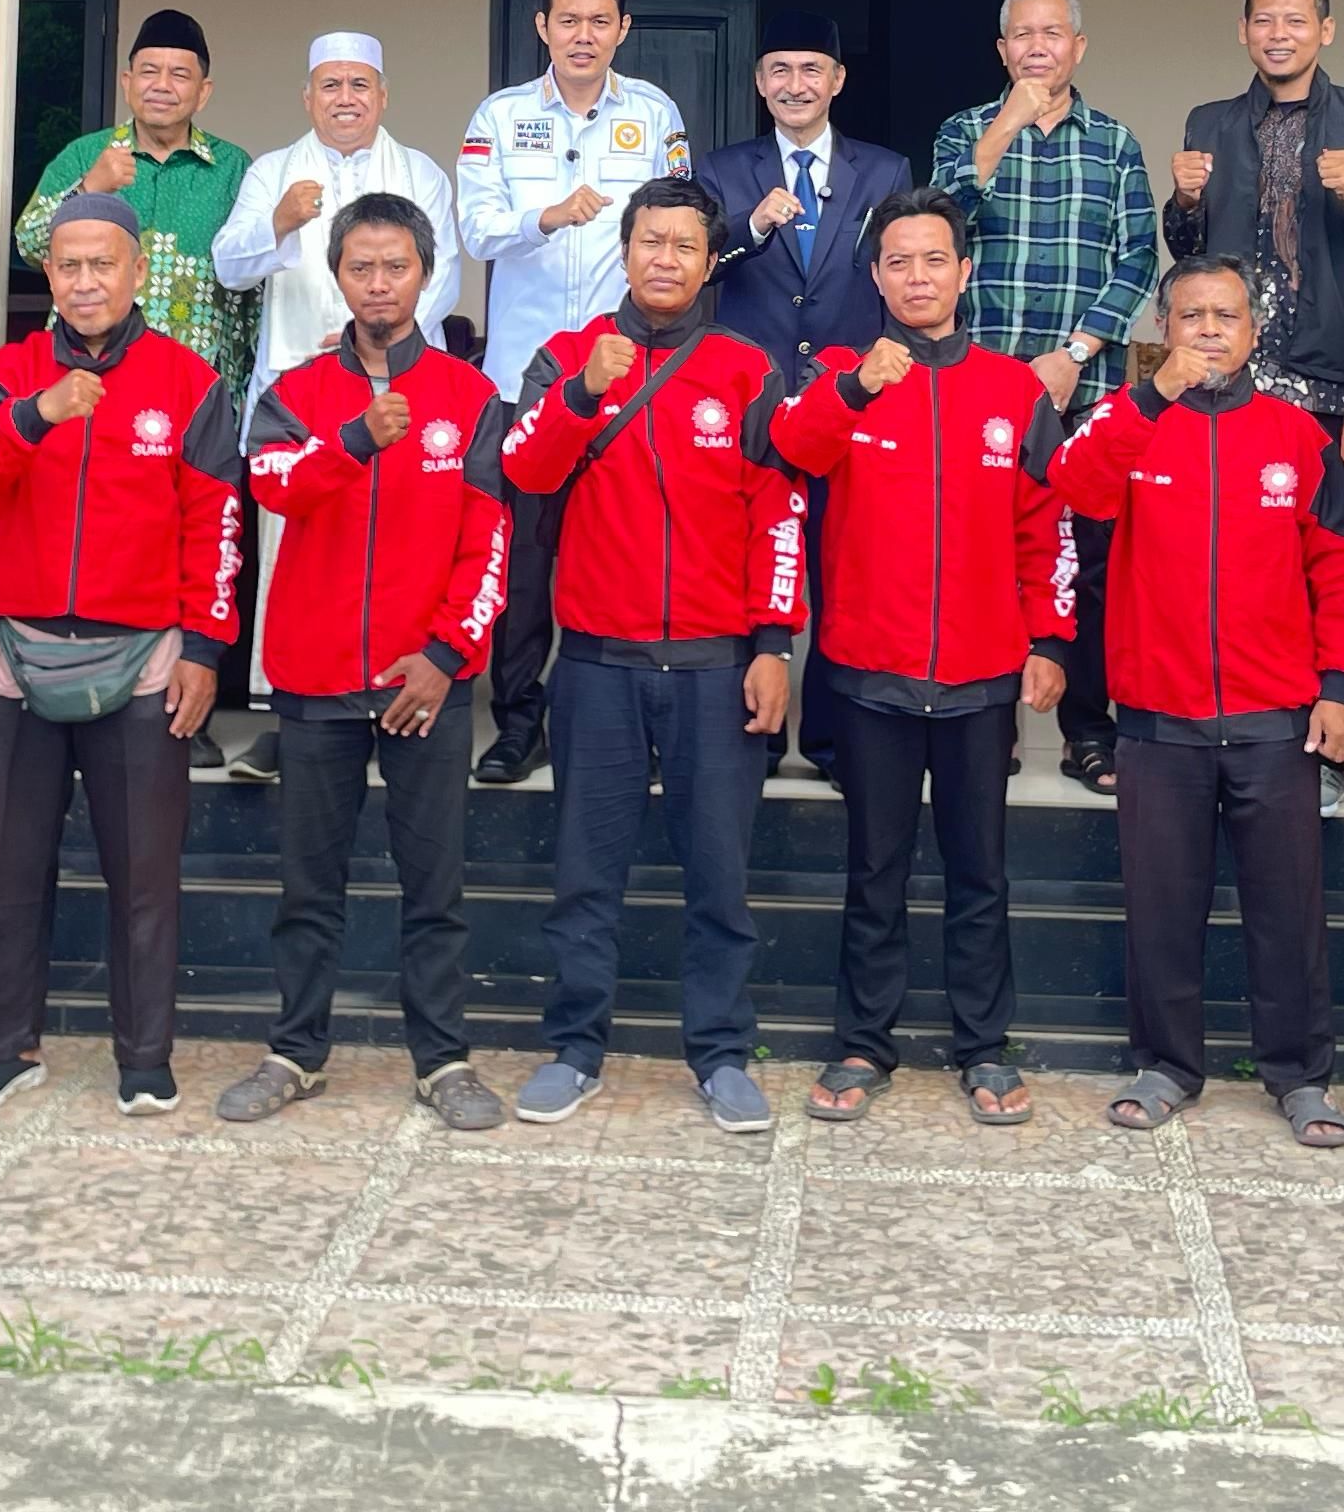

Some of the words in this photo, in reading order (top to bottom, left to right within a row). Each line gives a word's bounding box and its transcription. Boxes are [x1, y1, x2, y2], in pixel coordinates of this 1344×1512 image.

[516, 121, 551, 131] WAKIL
[693, 435, 733, 449] SUMU
[421, 456, 463, 473] SUMU
